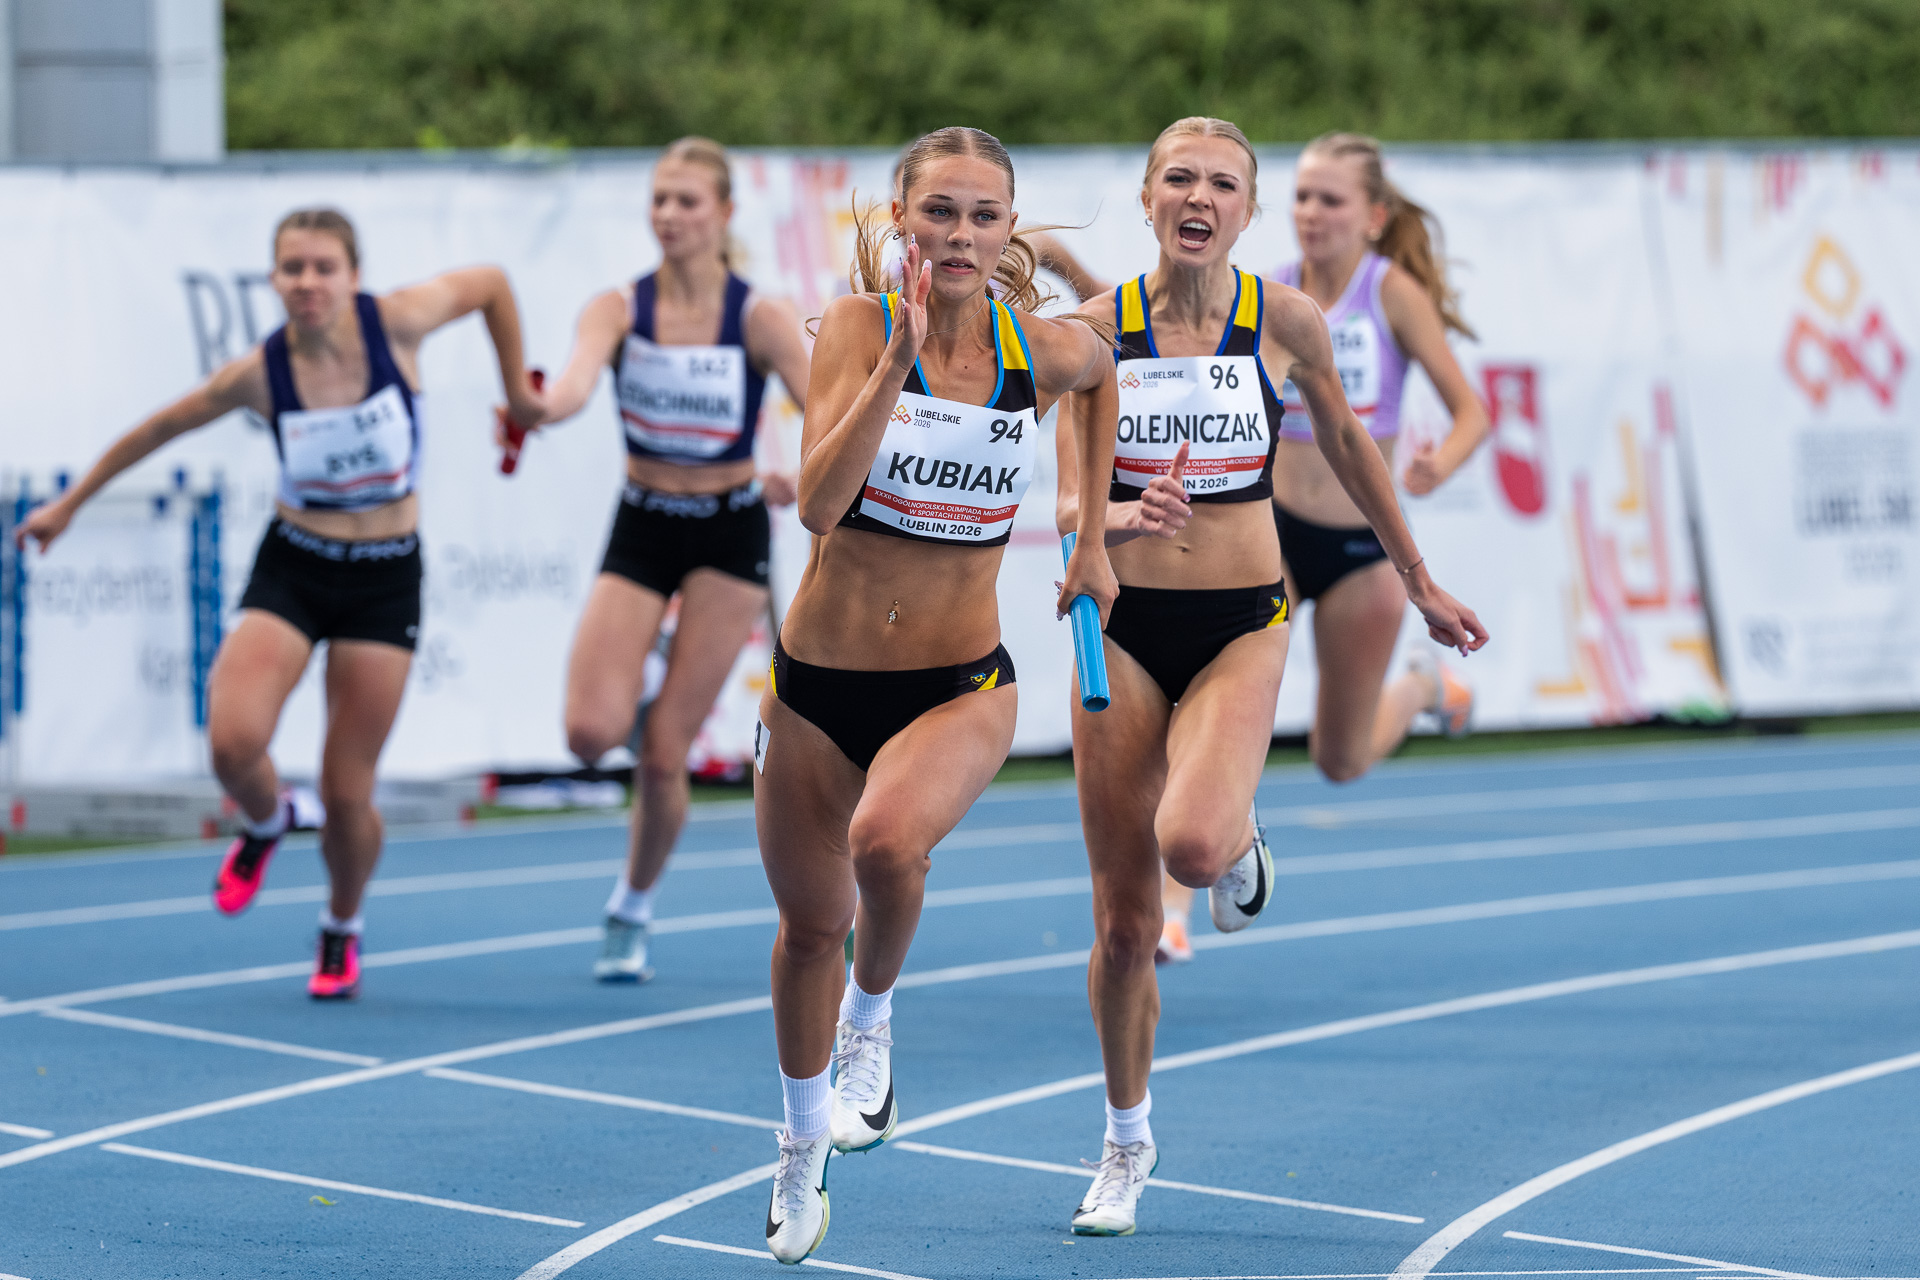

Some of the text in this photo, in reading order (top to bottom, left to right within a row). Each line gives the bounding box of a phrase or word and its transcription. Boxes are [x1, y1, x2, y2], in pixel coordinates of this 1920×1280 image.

[1142, 370, 1184, 380] LUBELSKIE
[1209, 364, 1239, 390] 96
[1142, 380, 1159, 389] 2026
[913, 418, 931, 430] 2026
[915, 408, 962, 425] LUBELSKIE
[988, 418, 1024, 445] 94
[1117, 412, 1263, 444] OLEJNICZAK
[1137, 459, 1191, 468] OGÓLNOPOA
[886, 451, 1021, 495] KUBIAK
[1199, 476, 1229, 489] 2026
[874, 490, 892, 500] XXXII
[892, 496, 945, 511] OGÓLNOPOLSKA
[946, 505, 982, 516] OLIMPIADA
[917, 509, 953, 519] SPORTACH
[953, 513, 981, 522] LETNICH
[899, 516, 983, 536] LUBLIN 2026
